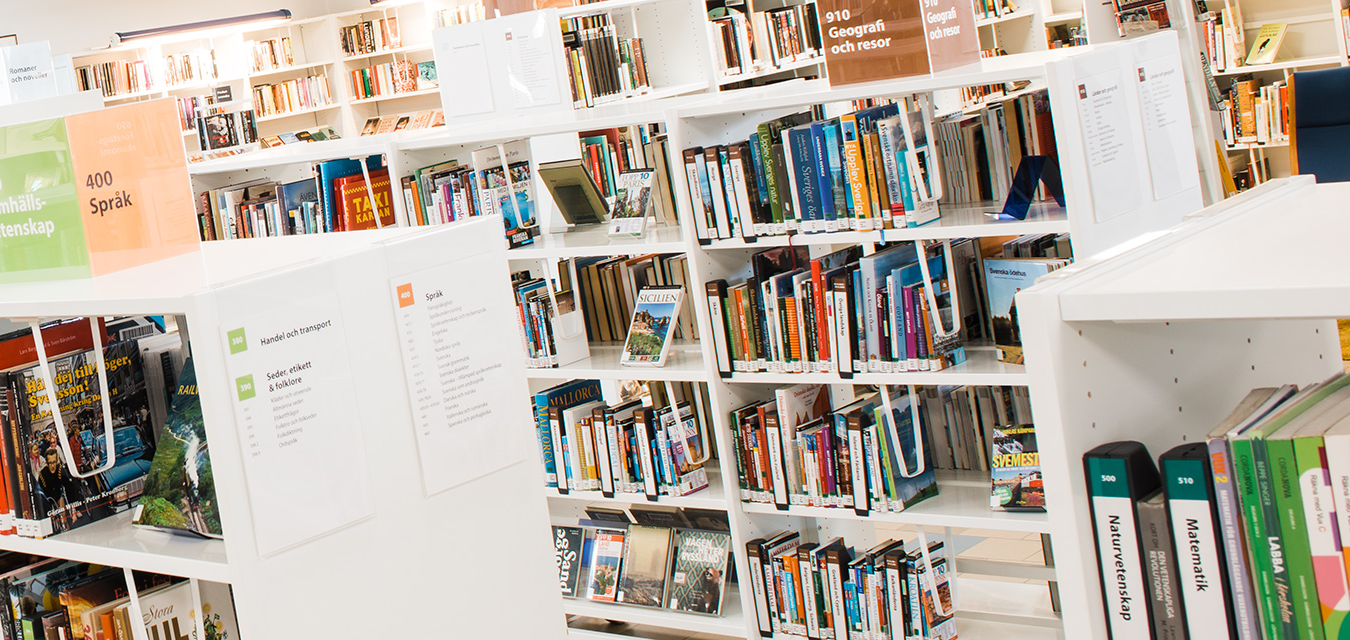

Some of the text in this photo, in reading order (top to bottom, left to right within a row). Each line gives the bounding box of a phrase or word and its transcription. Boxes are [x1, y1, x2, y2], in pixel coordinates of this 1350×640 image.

[826, 9, 850, 24] 910
[926, 7, 957, 24] Geografi
[828, 19, 886, 39] Geografi
[929, 24, 960, 40] och resor
[831, 36, 891, 54] och resor
[9, 64, 38, 74] Romaner
[10, 76, 24, 84] och
[24, 72, 48, 82] noveller
[640, 172, 650, 180] 10
[760, 133, 778, 204] Upplev Sveriges natur
[86, 170, 113, 190] 400
[623, 180, 645, 188] PARIS
[800, 165, 816, 203] Sveriges
[847, 148, 866, 216] Upplev Sverige
[90, 190, 132, 216] Språk
[1009, 268, 1026, 276] ödehus
[426, 290, 444, 301] Språk
[638, 292, 678, 303] SICILIEN
[895, 306, 904, 337] GOTLAND
[232, 320, 332, 346] 380 Handel och transport
[432, 328, 448, 336] Engelska
[451, 356, 469, 366] grammatik
[54, 370, 72, 386] dej
[74, 364, 94, 380] till
[240, 361, 312, 392] 390 Seder, etikett
[269, 376, 302, 392] & folklore
[439, 370, 453, 378] Svenska
[550, 382, 600, 406] MALLORCA
[32, 412, 40, 420] En
[272, 402, 292, 412] Allmänna
[445, 403, 459, 411] Franska
[277, 427, 303, 439] Folkdiktning
[538, 404, 554, 464] MALLORCA
[608, 428, 619, 468] PORTUGAL
[1240, 454, 1254, 495] CORDANOVA
[1278, 457, 1292, 499] CORDANOVA
[1310, 474, 1318, 496] Räkna
[1313, 497, 1322, 511] med
[1211, 452, 1242, 590] VUX 2 MATEMATIK FÖR GRUNDLÄGGANDE
[1256, 461, 1266, 478] BEPPE
[1261, 478, 1271, 506] SINGER
[1267, 536, 1284, 573] LABBA
[684, 538, 713, 546] VÄGEN
[1177, 477, 1209, 592] 510 Matematik
[680, 550, 720, 563] RYSSLAND
[697, 546, 724, 556] HETER
[770, 540, 800, 557] AMSTERDAM
[1108, 514, 1132, 621] Naturvetenskap
[1149, 550, 1163, 602] REVOLUTIONEN
[765, 566, 774, 607] AMSTERDAM
[890, 574, 898, 611] Balkanländerna
[1159, 562, 1174, 619] VETENSKAPLIGA
[908, 576, 919, 620] KROATIEN
[142, 604, 174, 626] Stora
